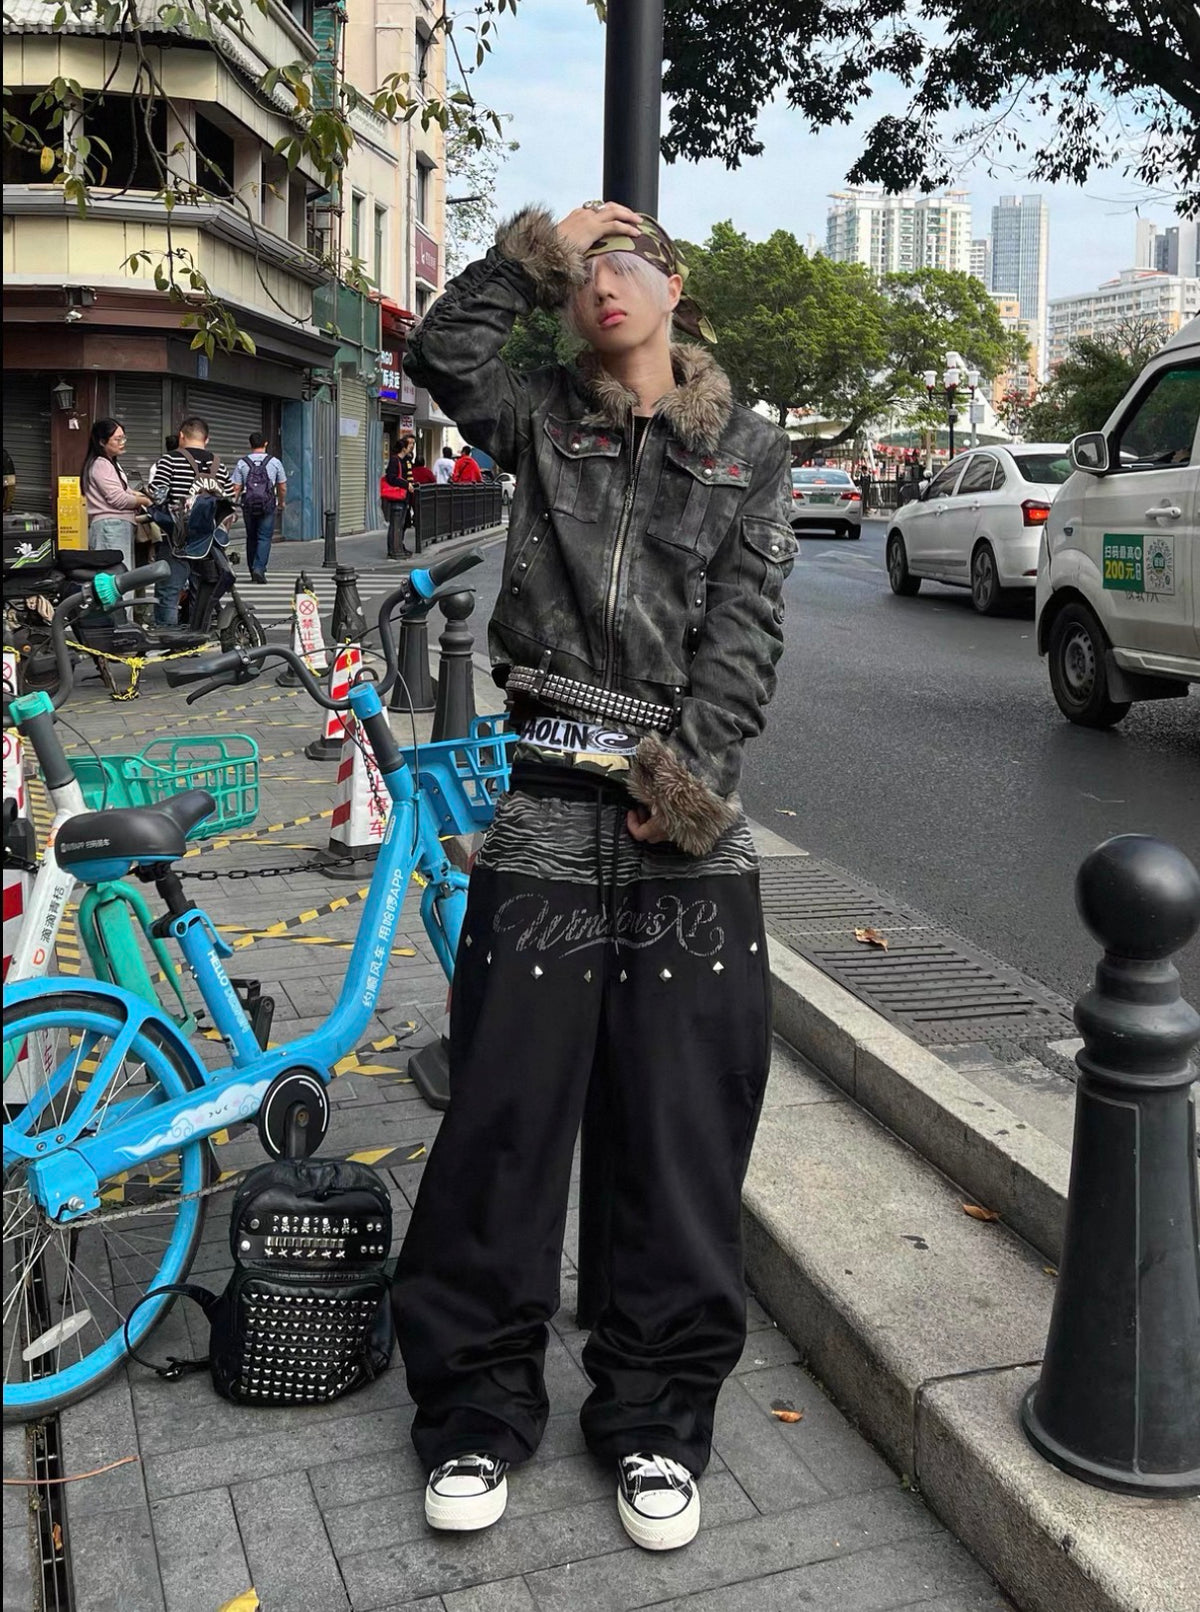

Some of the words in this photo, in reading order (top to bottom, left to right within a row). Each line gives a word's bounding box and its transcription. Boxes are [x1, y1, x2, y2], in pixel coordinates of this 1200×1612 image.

[1105, 560, 1135, 580] 200元
[41, 885, 65, 943] 滴滴青桔
[207, 949, 229, 987] HELLO
[362, 944, 386, 1008] 约顺风车
